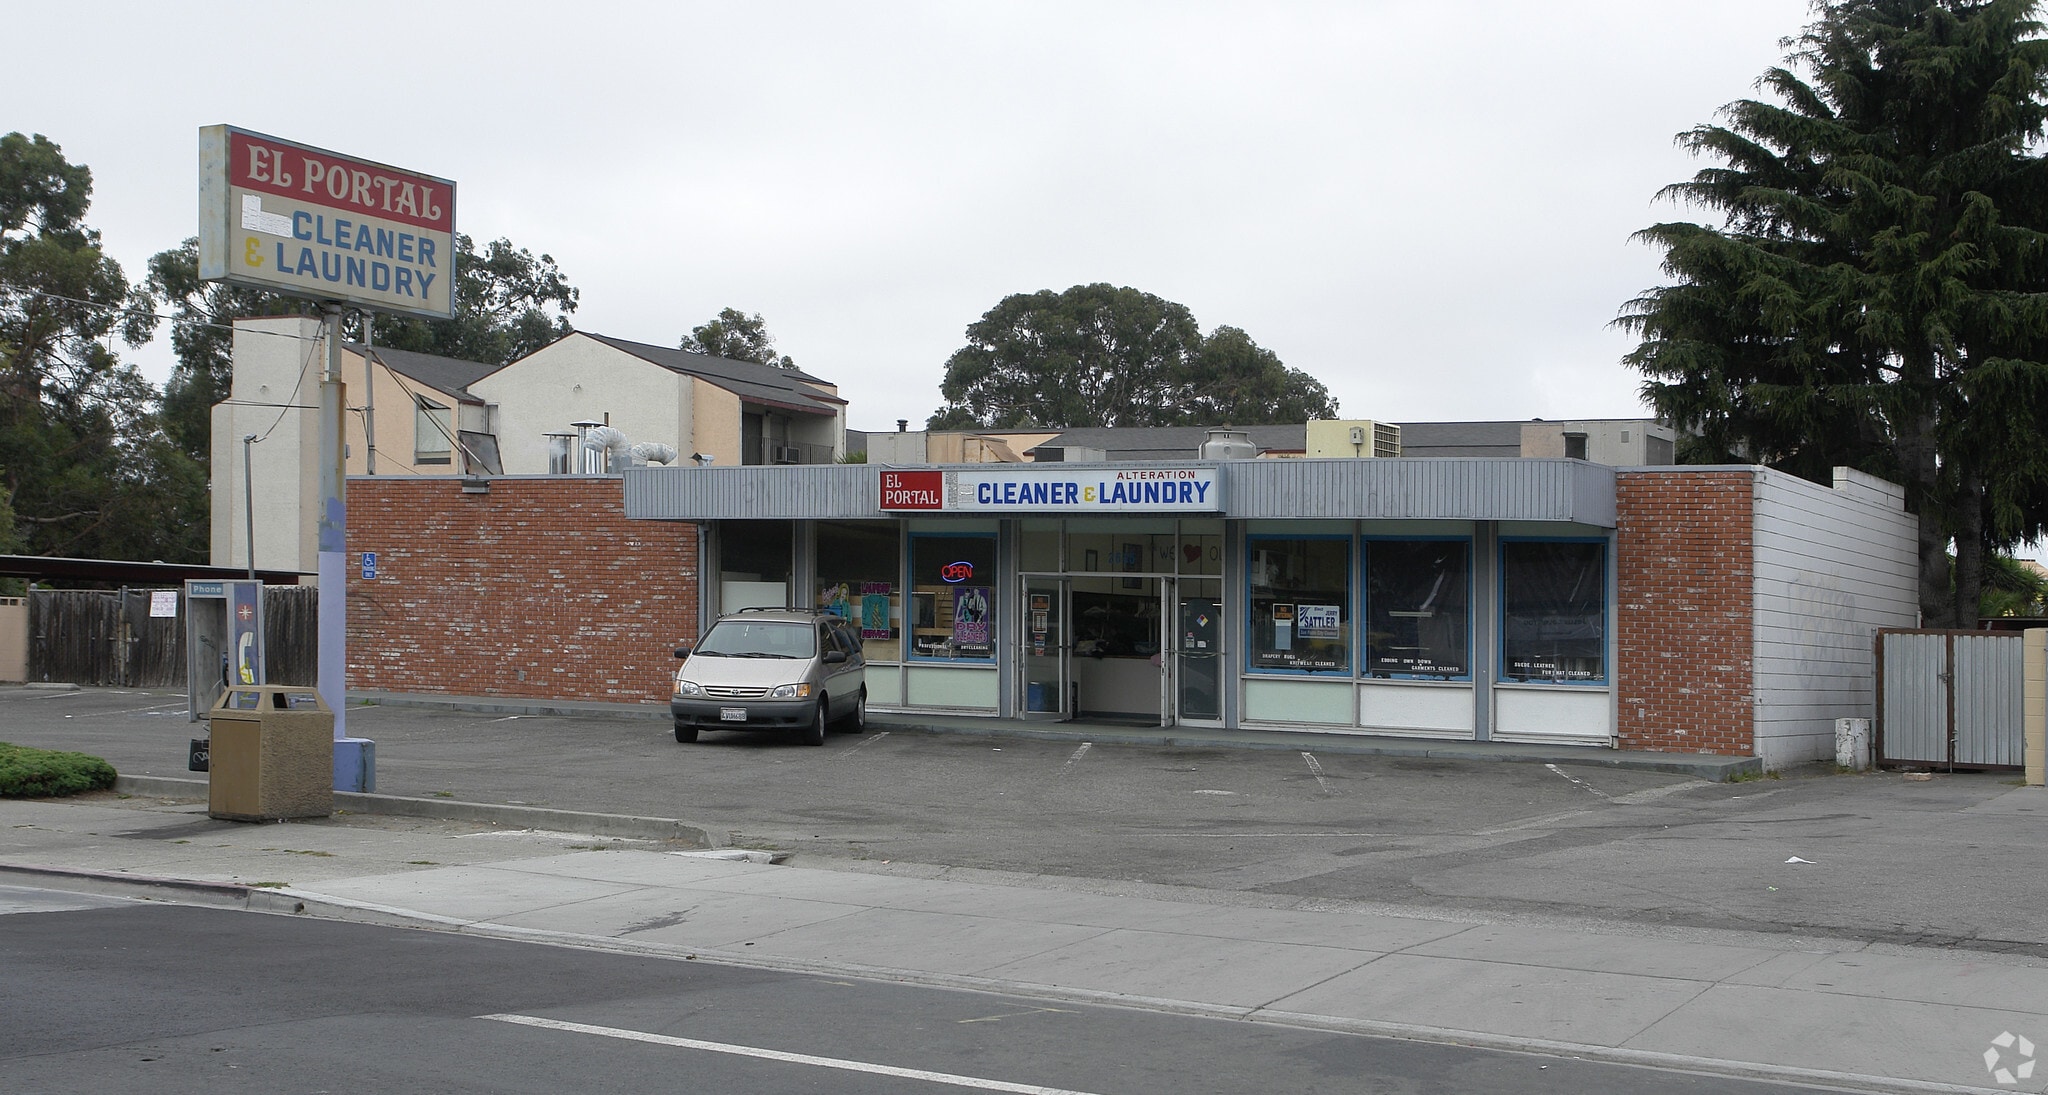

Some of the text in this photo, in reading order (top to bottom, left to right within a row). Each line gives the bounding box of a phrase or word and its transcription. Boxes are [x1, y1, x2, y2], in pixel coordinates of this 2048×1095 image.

[246, 144, 441, 220] EL PORTAL
[292, 210, 437, 268] CLEANER
[244, 236, 436, 299] & LAUNDRY
[886, 474, 902, 488] EL
[1117, 470, 1195, 480] ALTERATION
[885, 490, 939, 505] PORTAL
[978, 481, 1211, 505] CLEANER & LAUNDRY
[941, 565, 973, 578] OPEN
[193, 585, 222, 593] Phone
[956, 622, 986, 631] DRY
[1304, 616, 1336, 628] SATTLER
